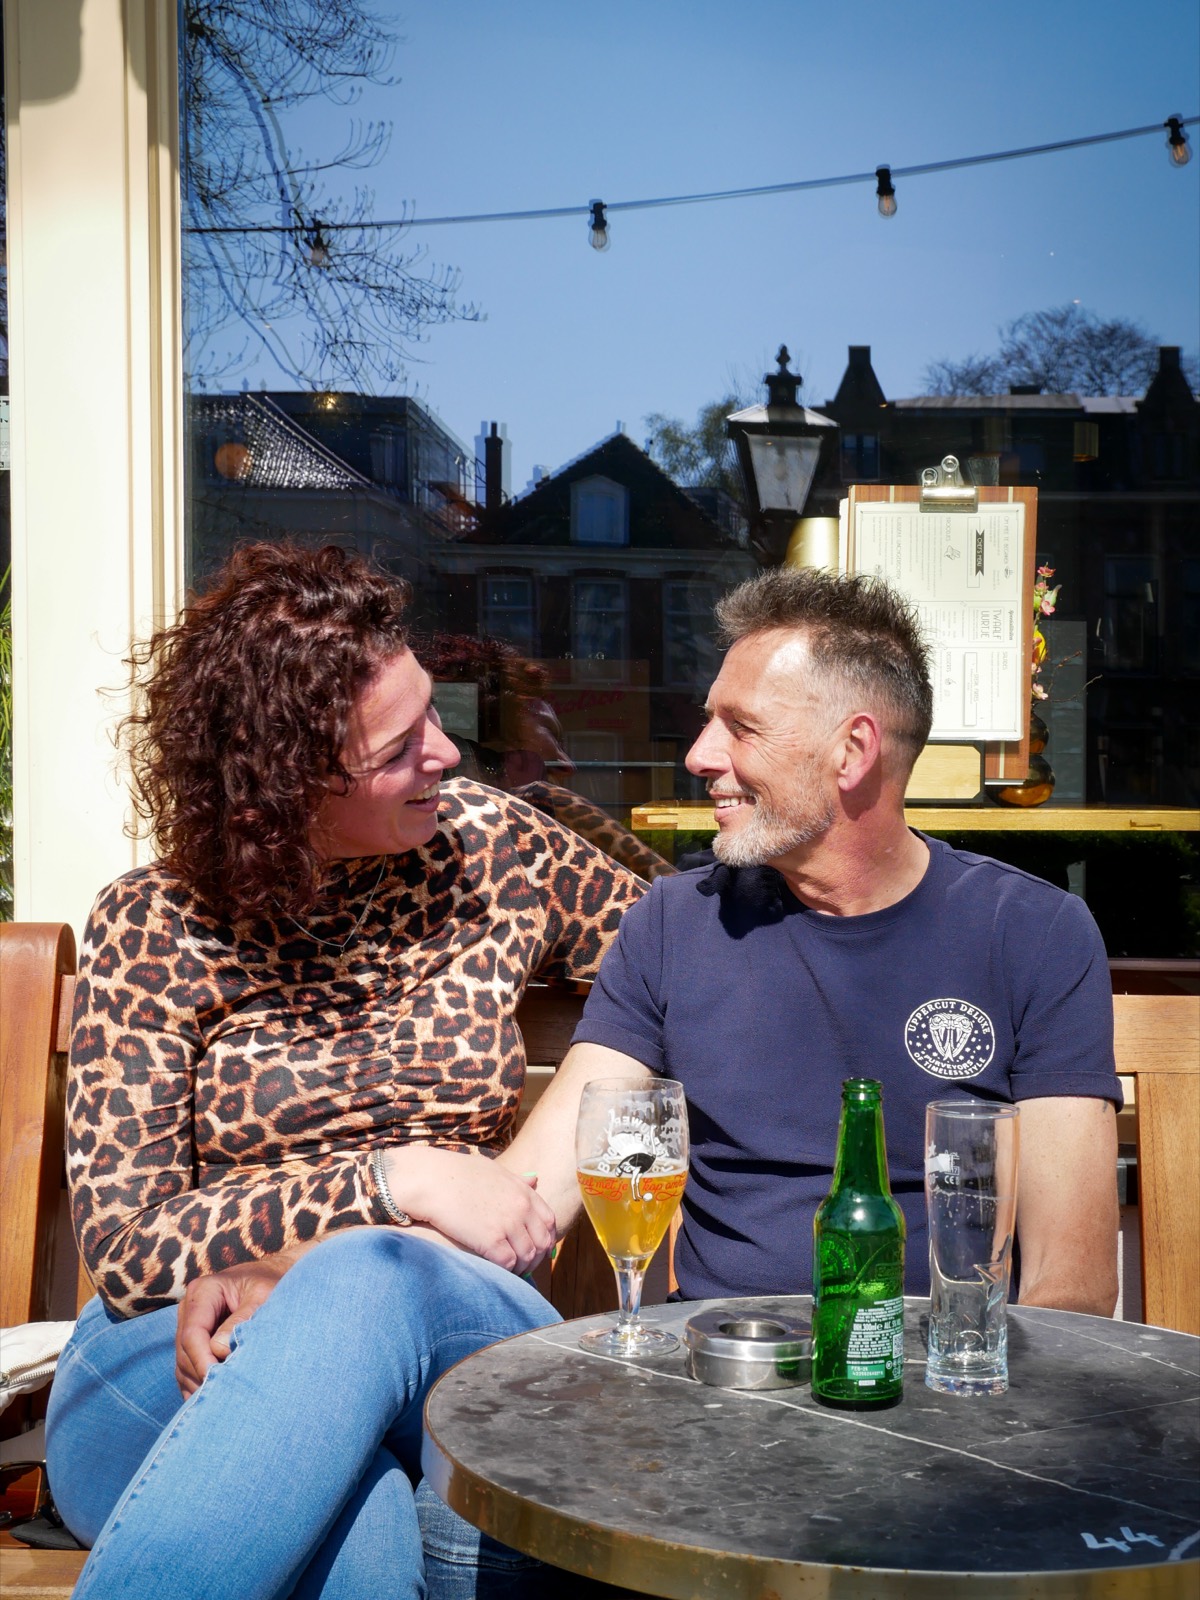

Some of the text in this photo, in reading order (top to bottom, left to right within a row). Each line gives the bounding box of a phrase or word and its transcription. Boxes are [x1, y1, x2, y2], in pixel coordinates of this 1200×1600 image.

[980, 610, 990, 638] UURTJE
[992, 609, 1002, 640] TWAALF
[907, 1001, 991, 1035] UPPERCUT DELUXE
[913, 1052, 986, 1076] OF TIMELESS STYLE
[923, 1054, 974, 1070] PURVEYORS
[1080, 1526, 1165, 1553] 44
